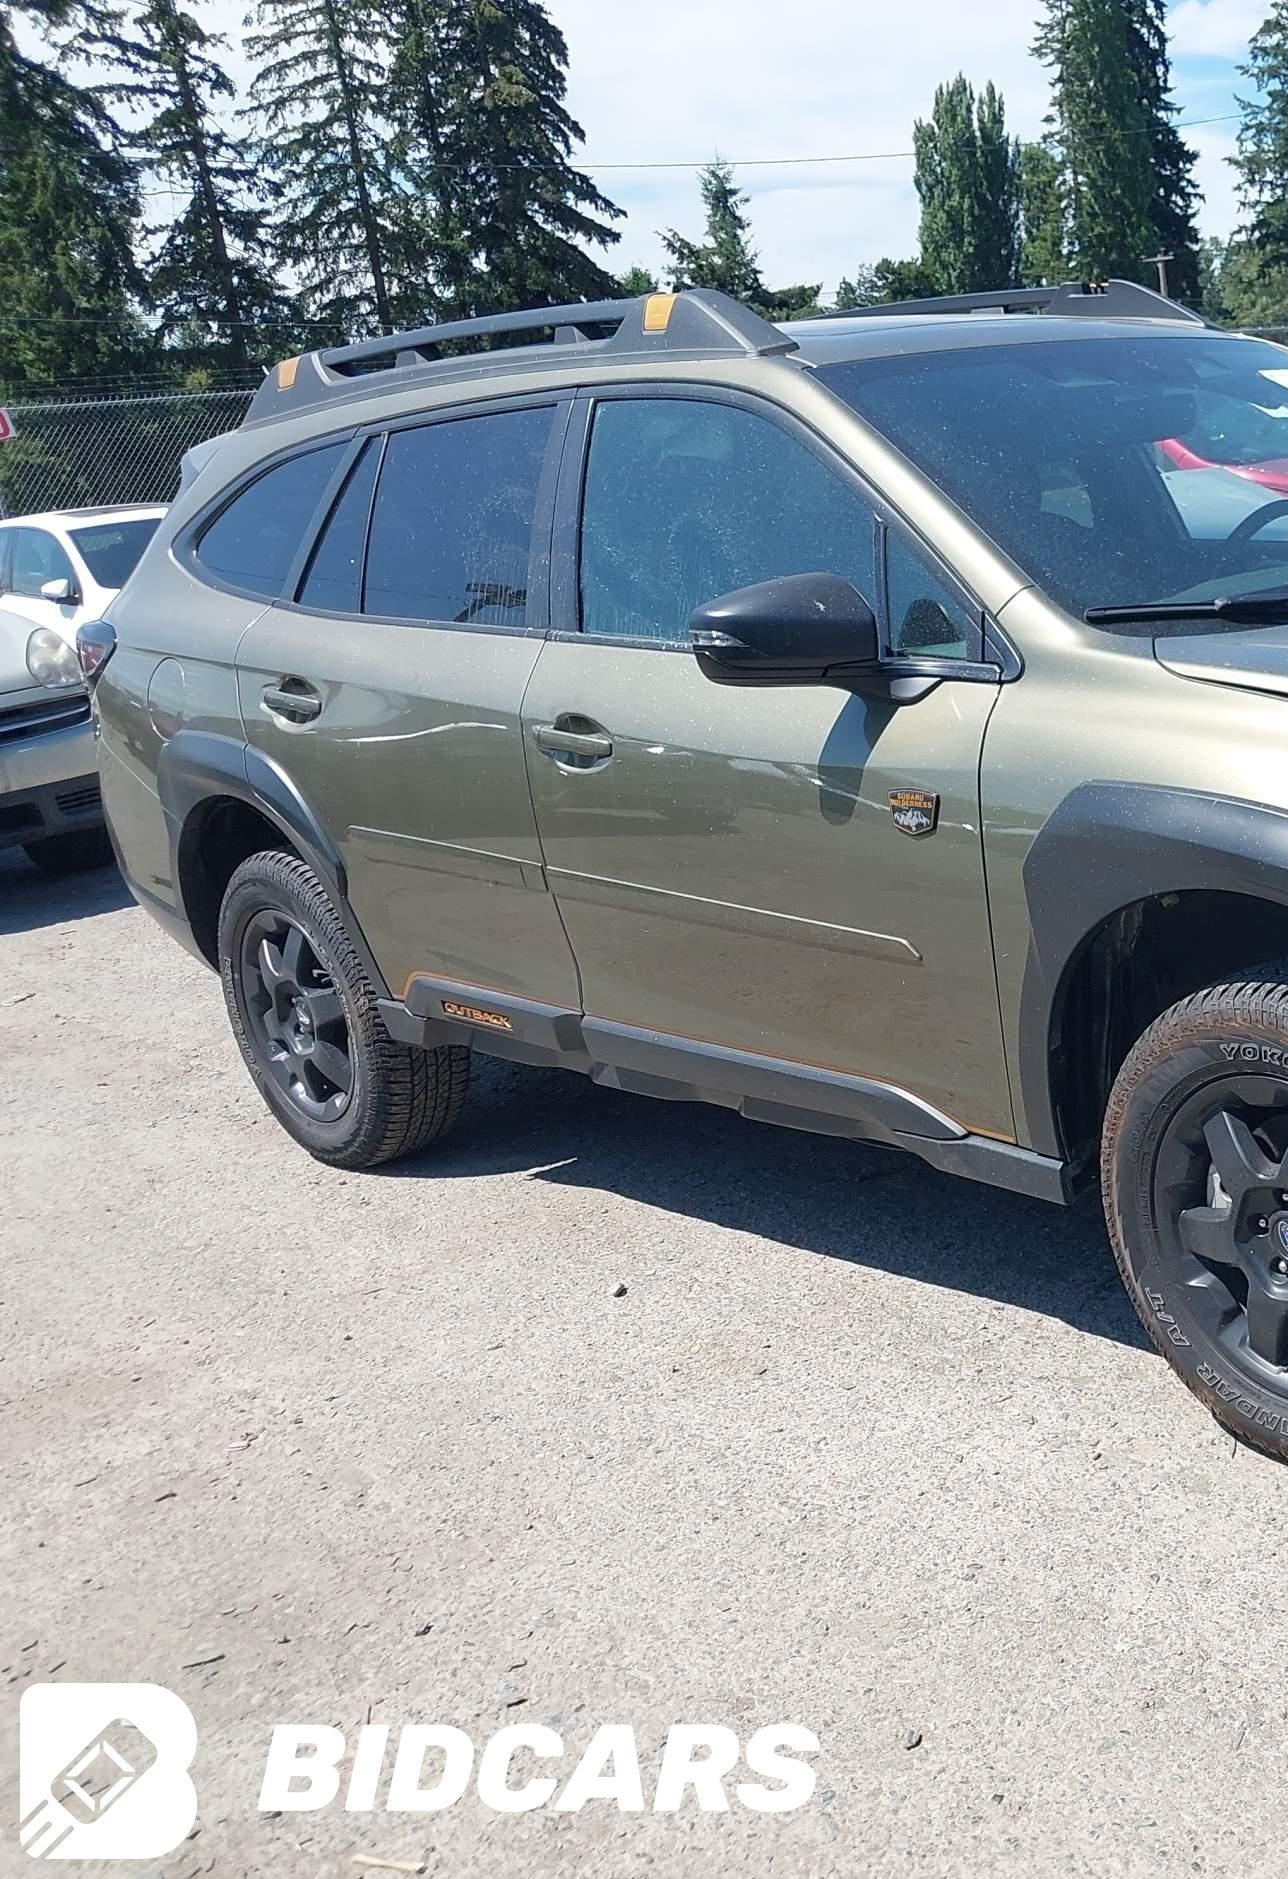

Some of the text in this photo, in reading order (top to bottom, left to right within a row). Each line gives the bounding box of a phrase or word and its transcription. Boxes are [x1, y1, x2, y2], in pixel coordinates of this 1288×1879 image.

[890, 799, 933, 809] WILDERNESS
[897, 792, 924, 801] SUBARU
[444, 1002, 513, 1029] OUTBACK
[1144, 1286, 1192, 1348] A/T
